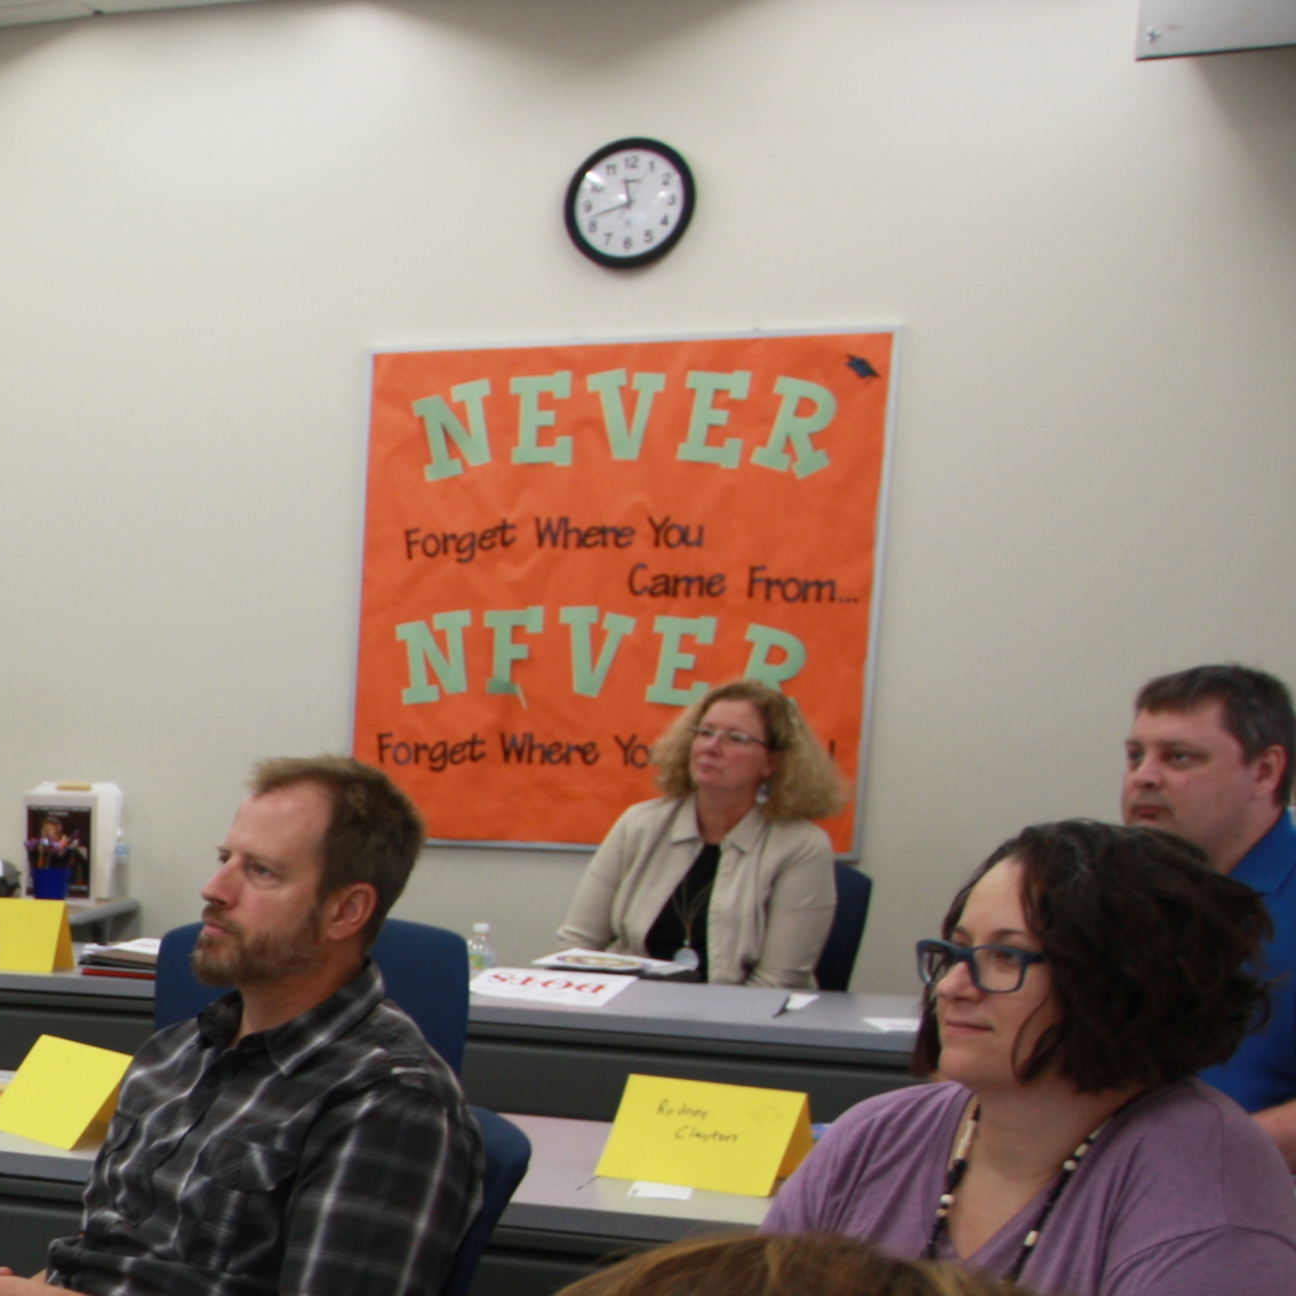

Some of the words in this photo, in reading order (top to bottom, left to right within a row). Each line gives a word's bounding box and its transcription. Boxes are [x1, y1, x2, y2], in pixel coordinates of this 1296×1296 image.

[624, 155, 640, 169] 12
[663, 173, 672, 186] 2
[582, 200, 593, 213] 9
[667, 195, 677, 206] 3
[588, 219, 597, 233] 8
[660, 214, 670, 227] 4
[603, 232, 612, 245] 7
[623, 236, 633, 249] 6
[644, 229, 654, 243] 5
[411, 368, 837, 482] NEVER
[404, 518, 516, 563] Forget
[535, 516, 636, 550] Where
[647, 515, 705, 549] You
[628, 564, 726, 598] Came
[377, 732, 486, 771] Forget
[501, 732, 600, 767] Where
[614, 733, 651, 768] Yo
